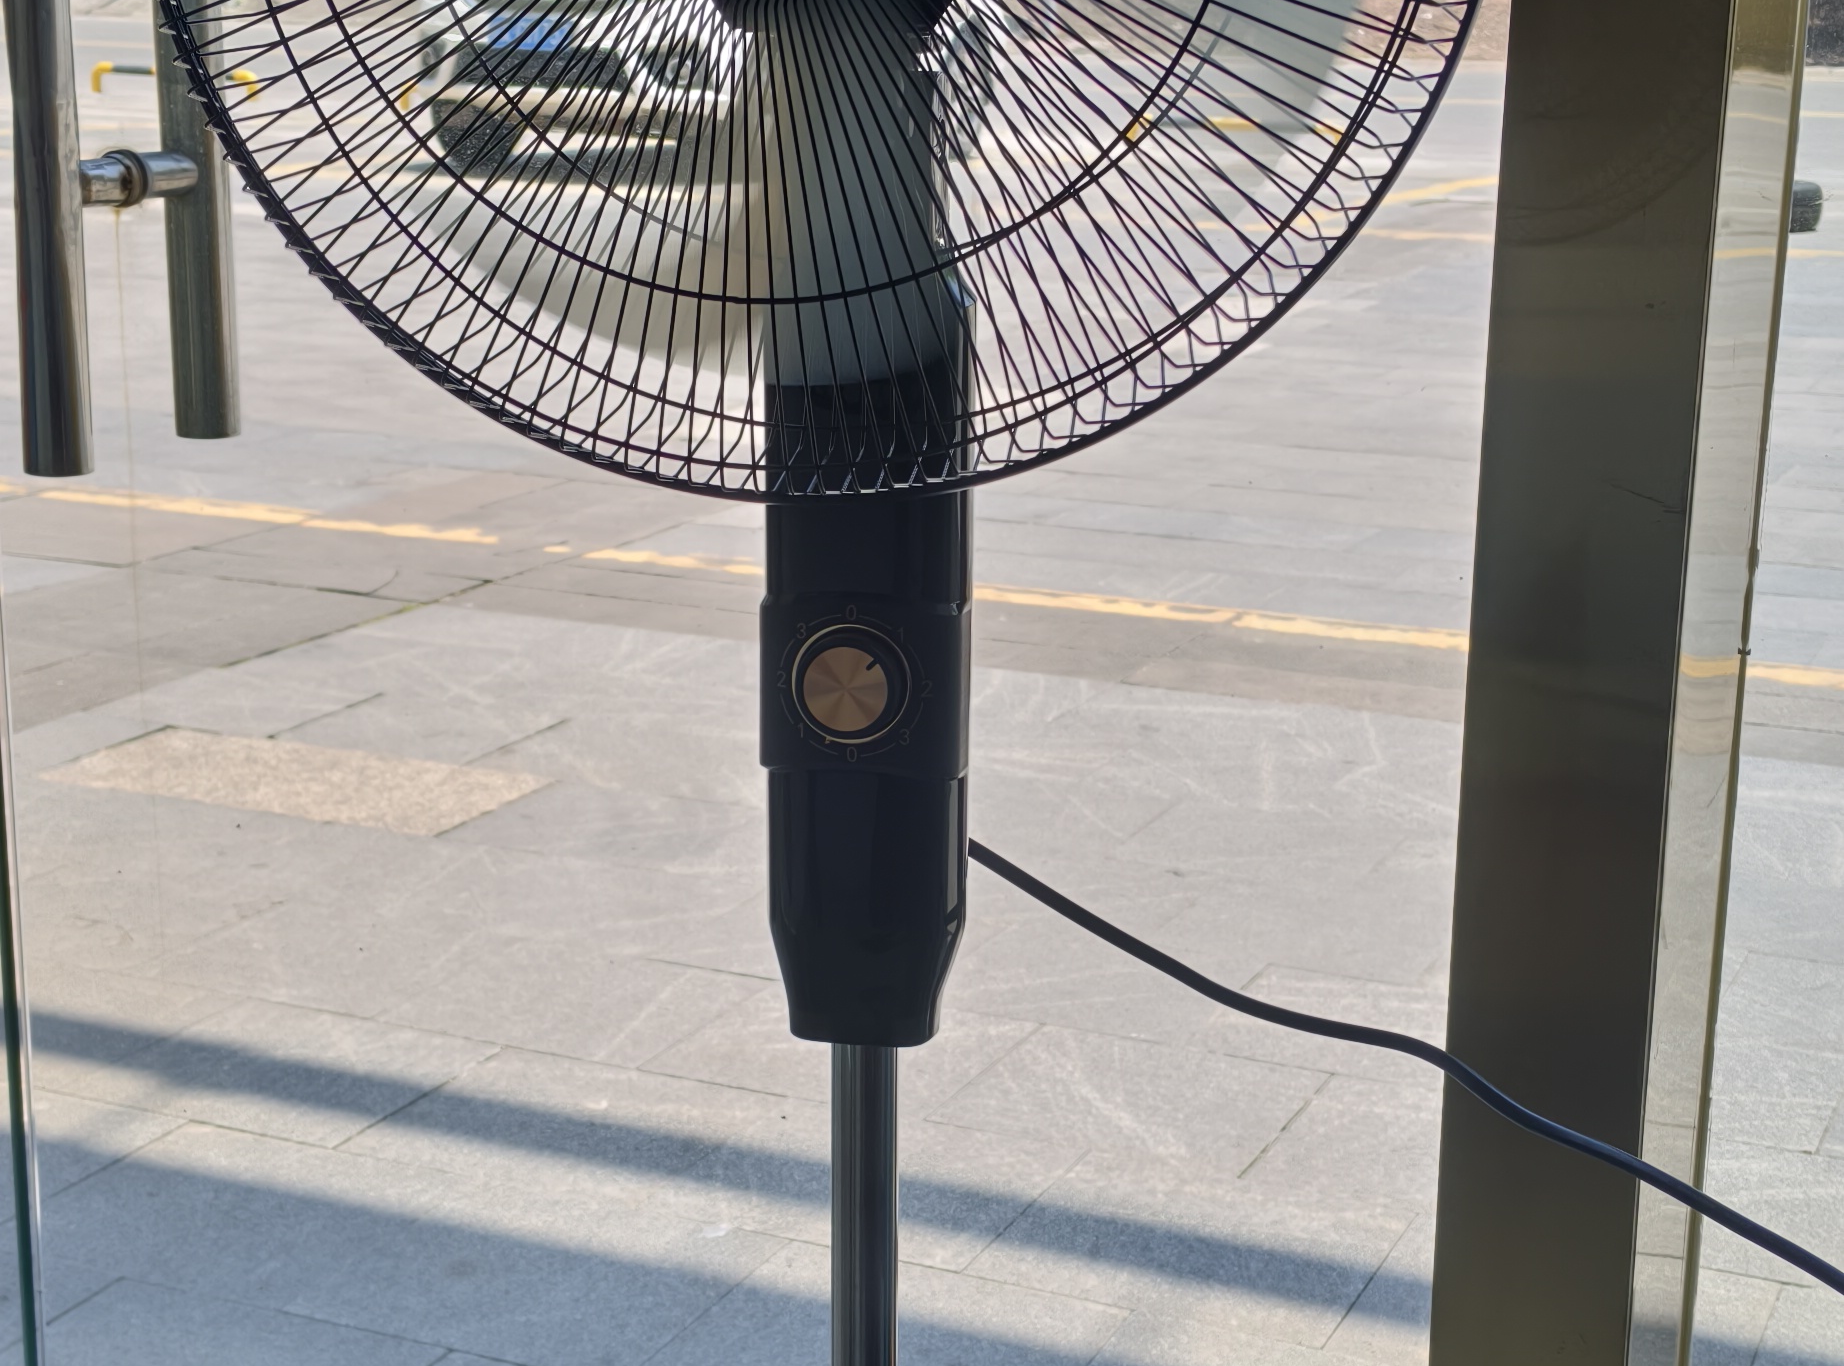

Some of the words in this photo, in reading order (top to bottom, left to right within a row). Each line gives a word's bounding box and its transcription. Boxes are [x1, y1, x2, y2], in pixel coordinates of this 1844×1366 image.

[845, 604, 857, 621] 0
[796, 622, 807, 639] 3
[897, 627, 904, 644] 1
[776, 670, 787, 688] 2
[920, 680, 933, 698] 2
[797, 723, 804, 738] 1
[898, 729, 910, 745] 3
[846, 746, 858, 762] 0
